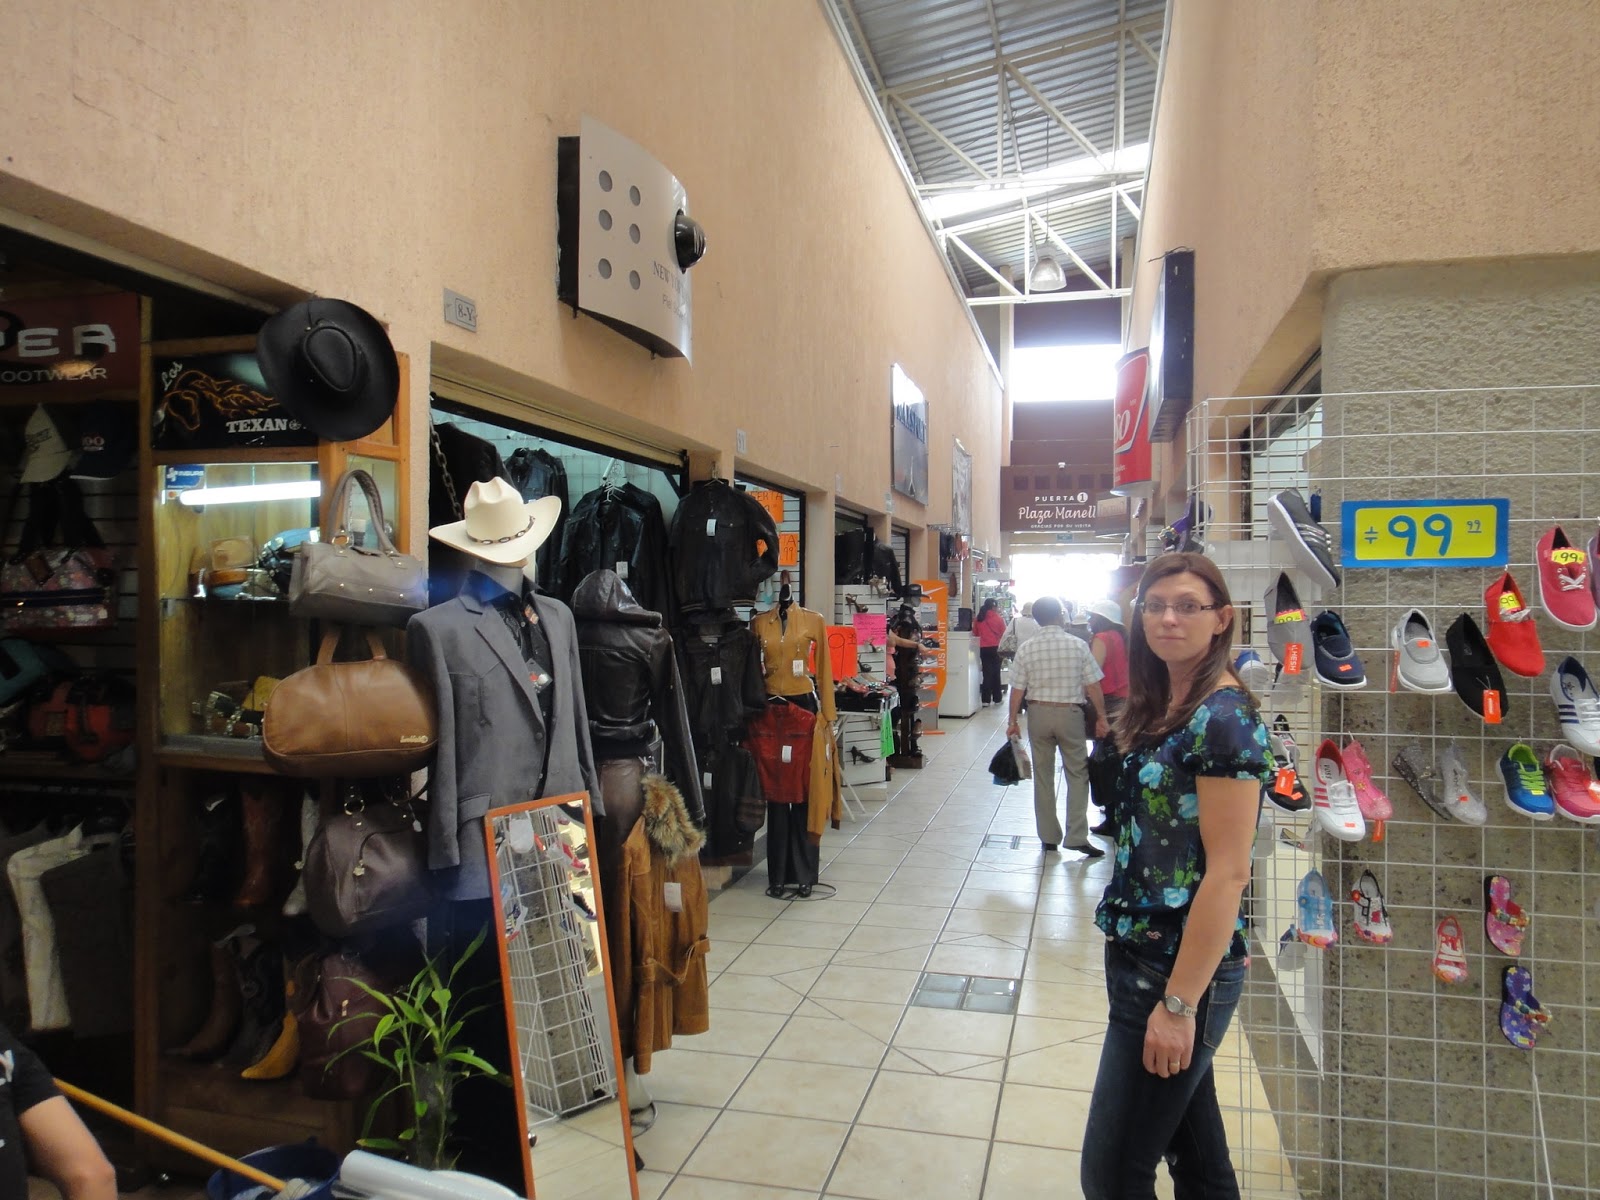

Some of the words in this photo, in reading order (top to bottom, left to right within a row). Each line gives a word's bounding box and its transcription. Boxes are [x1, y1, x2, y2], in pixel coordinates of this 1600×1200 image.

[457, 303, 475, 321] 8-Y
[0, 323, 117, 358] ER
[1018, 506, 1054, 524] Plaza
[1055, 505, 1096, 520] Manell
[1388, 513, 1453, 557] 99
[1467, 520, 1482, 533] 99
[938, 620, 946, 629] IT
[938, 631, 946, 645] DO
[938, 647, 946, 671] JUST
